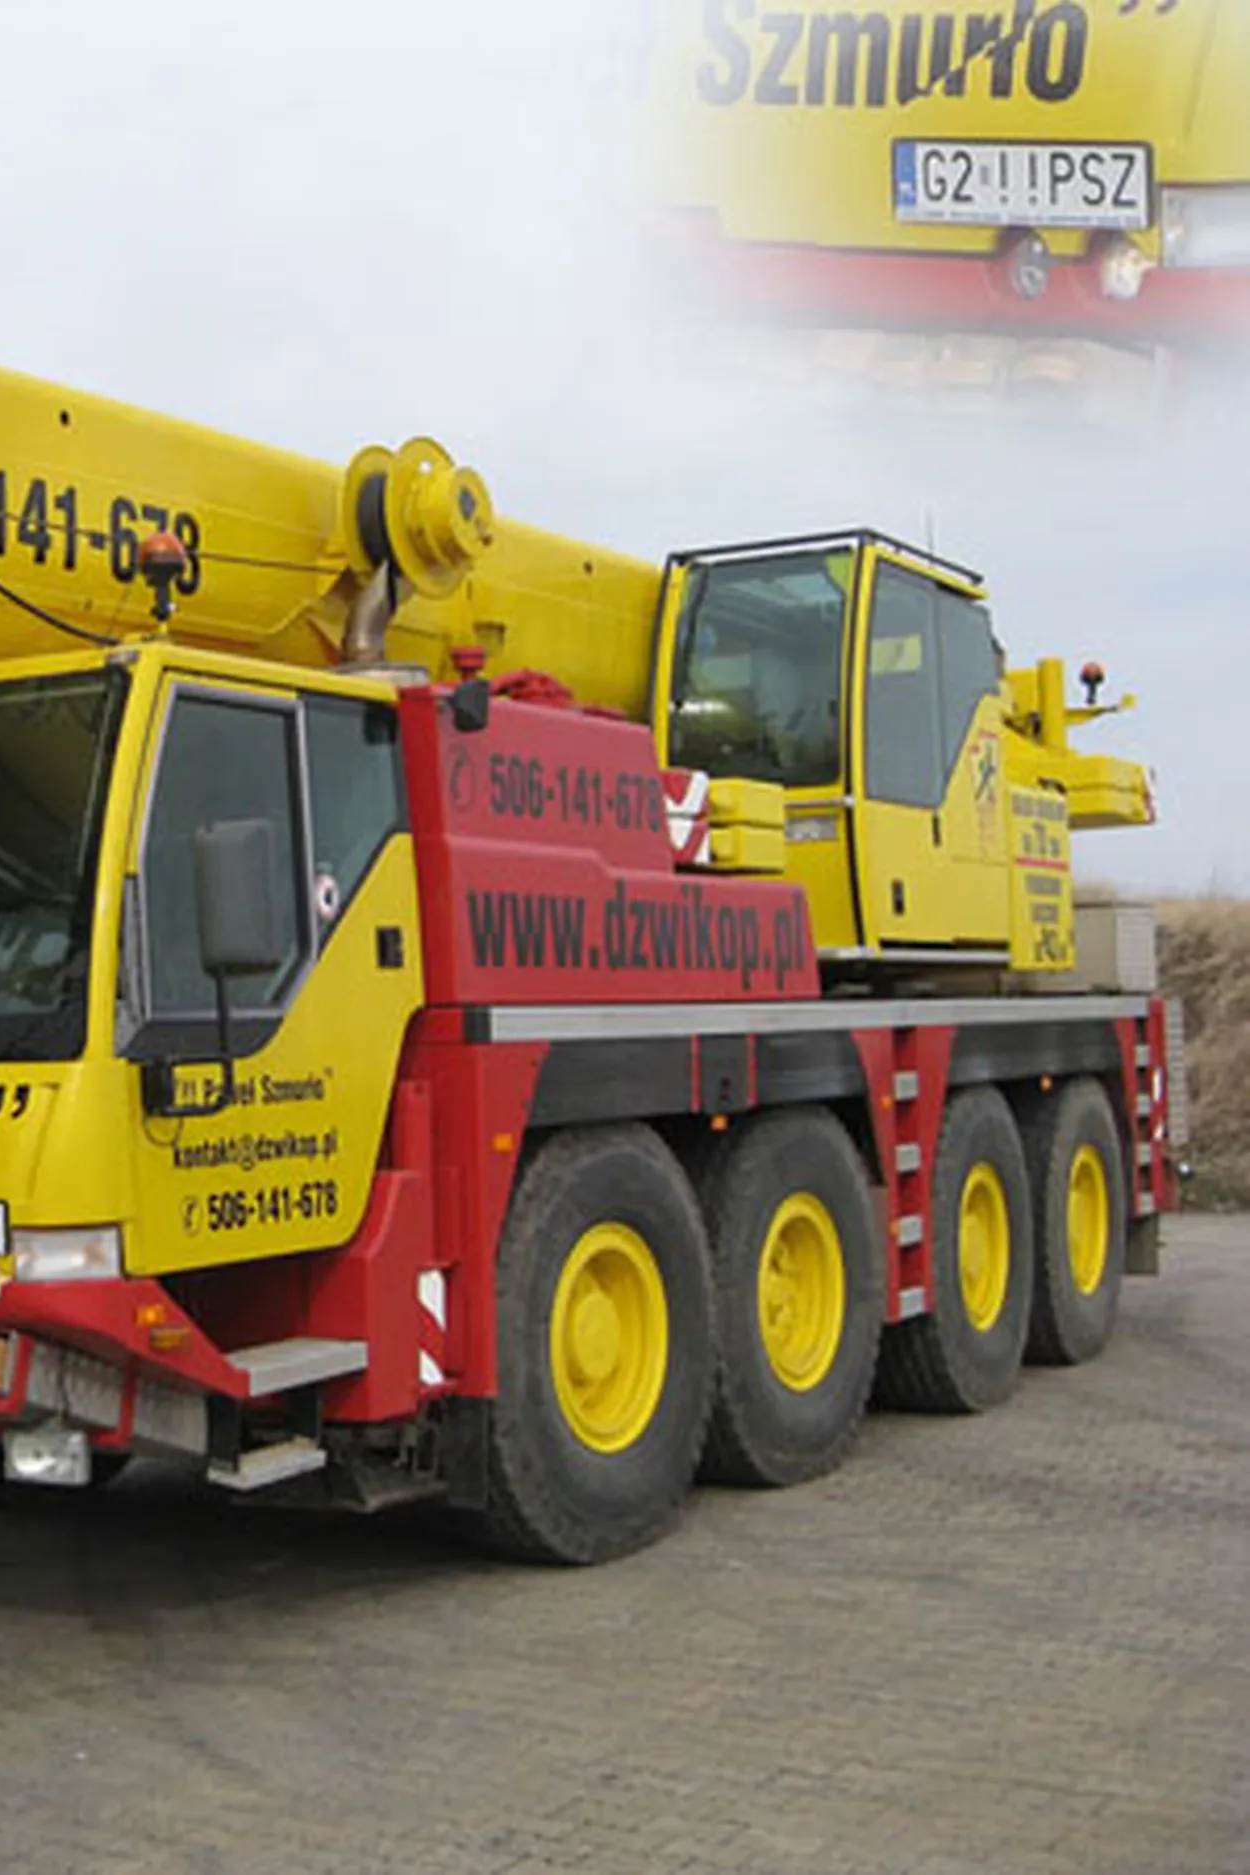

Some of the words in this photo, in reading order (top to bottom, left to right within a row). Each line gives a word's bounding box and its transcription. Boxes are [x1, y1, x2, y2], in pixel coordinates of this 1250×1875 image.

[489, 753, 661, 833] 506-141-678
[466, 877, 805, 991] www.dzwikop.pl
[207, 1179, 337, 1231] 506-141-678
